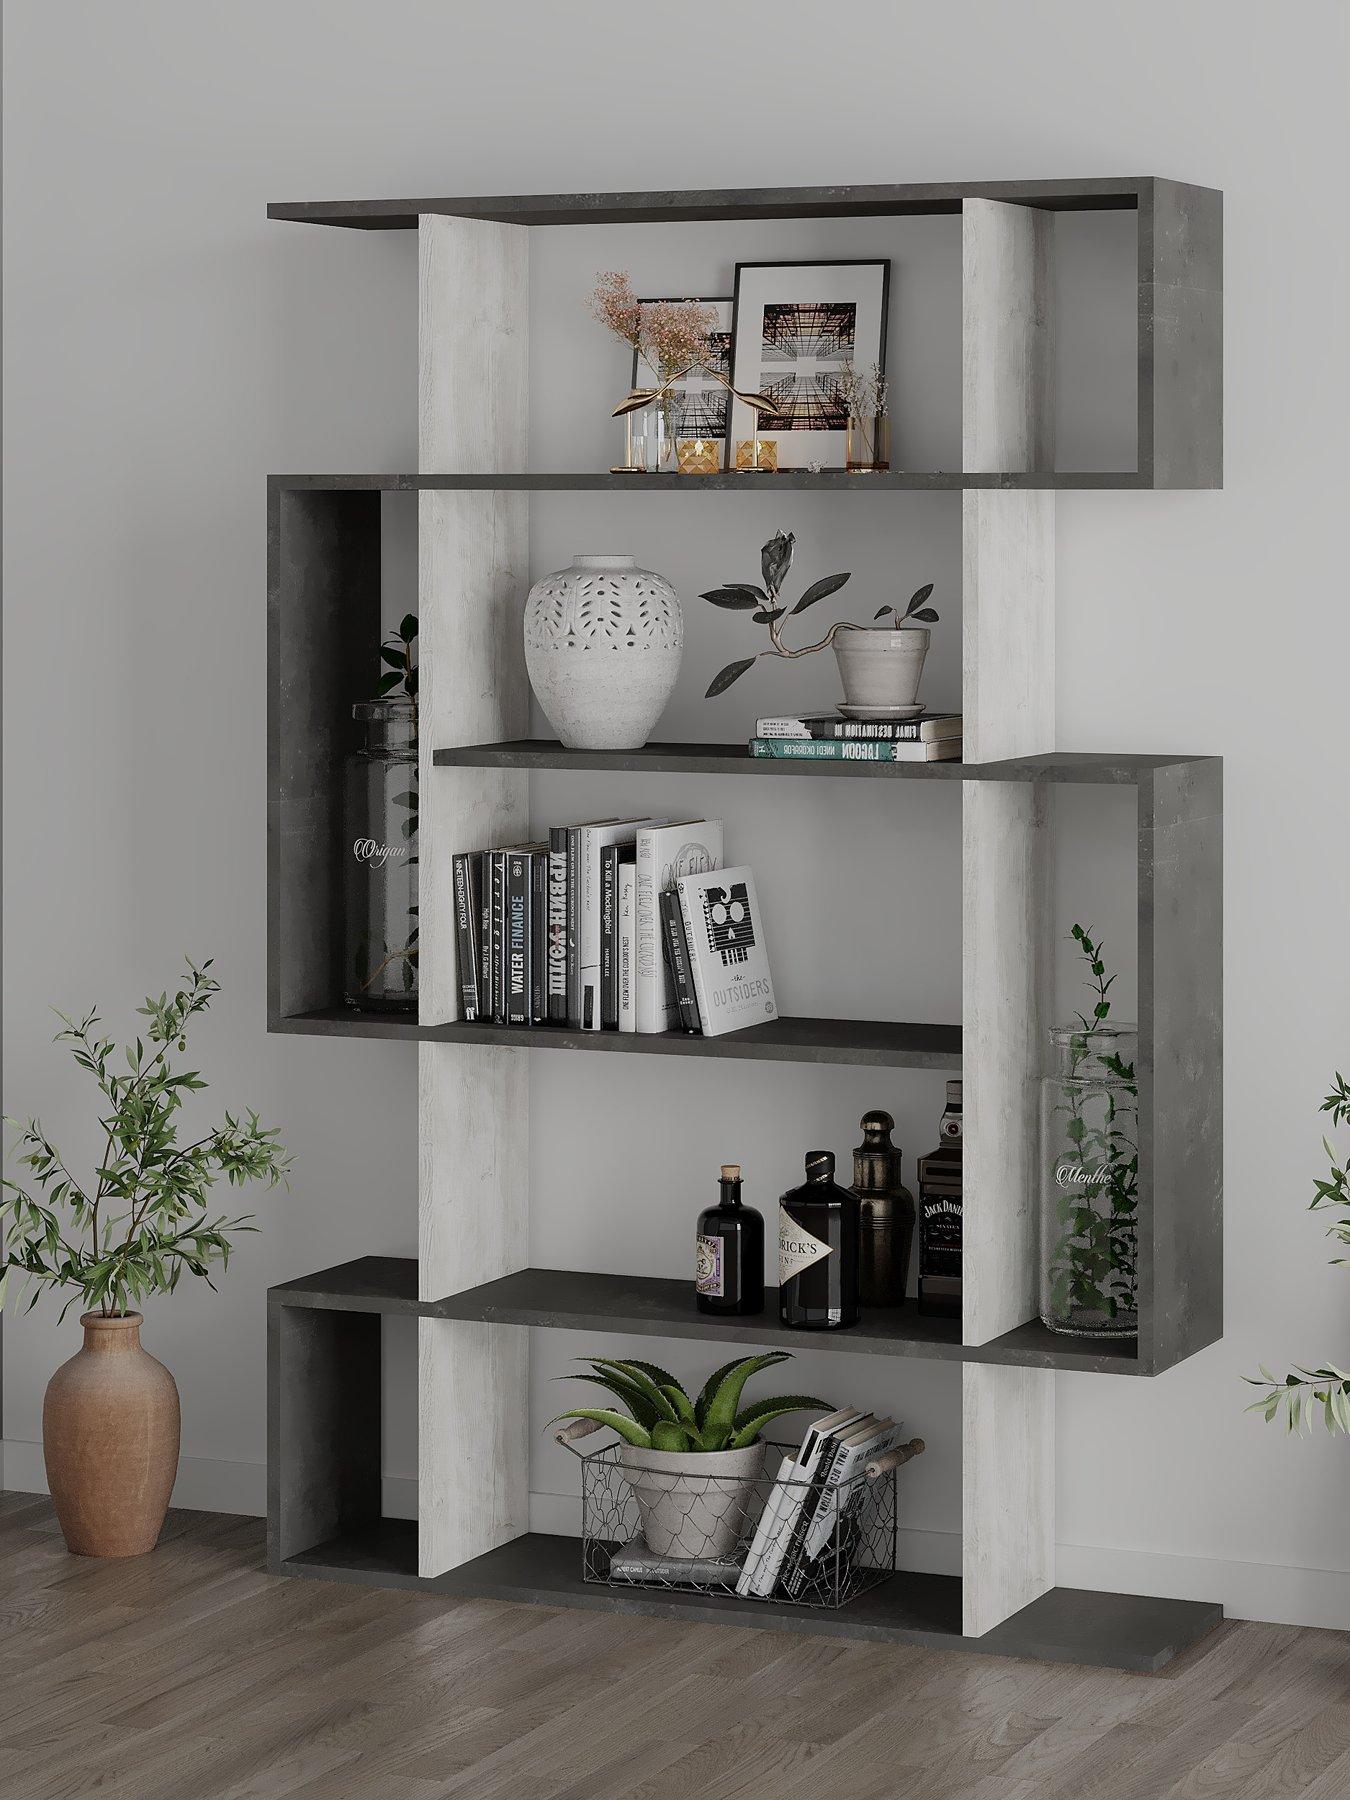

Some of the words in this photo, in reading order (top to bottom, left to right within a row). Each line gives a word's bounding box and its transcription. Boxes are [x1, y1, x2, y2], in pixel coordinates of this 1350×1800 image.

[353, 837, 406, 869] Origan
[604, 859, 613, 868] To
[604, 870, 613, 881] Kill
[511, 895, 524, 949] FINANCE
[603, 888, 613, 935] Mockingbird
[511, 953, 524, 995] WATER
[713, 977, 770, 1007] OUTSIDERS
[1056, 1162, 1113, 1189] Menthe
[924, 1203, 943, 1218] JACK
[838, 1446, 850, 1466] FINAL
